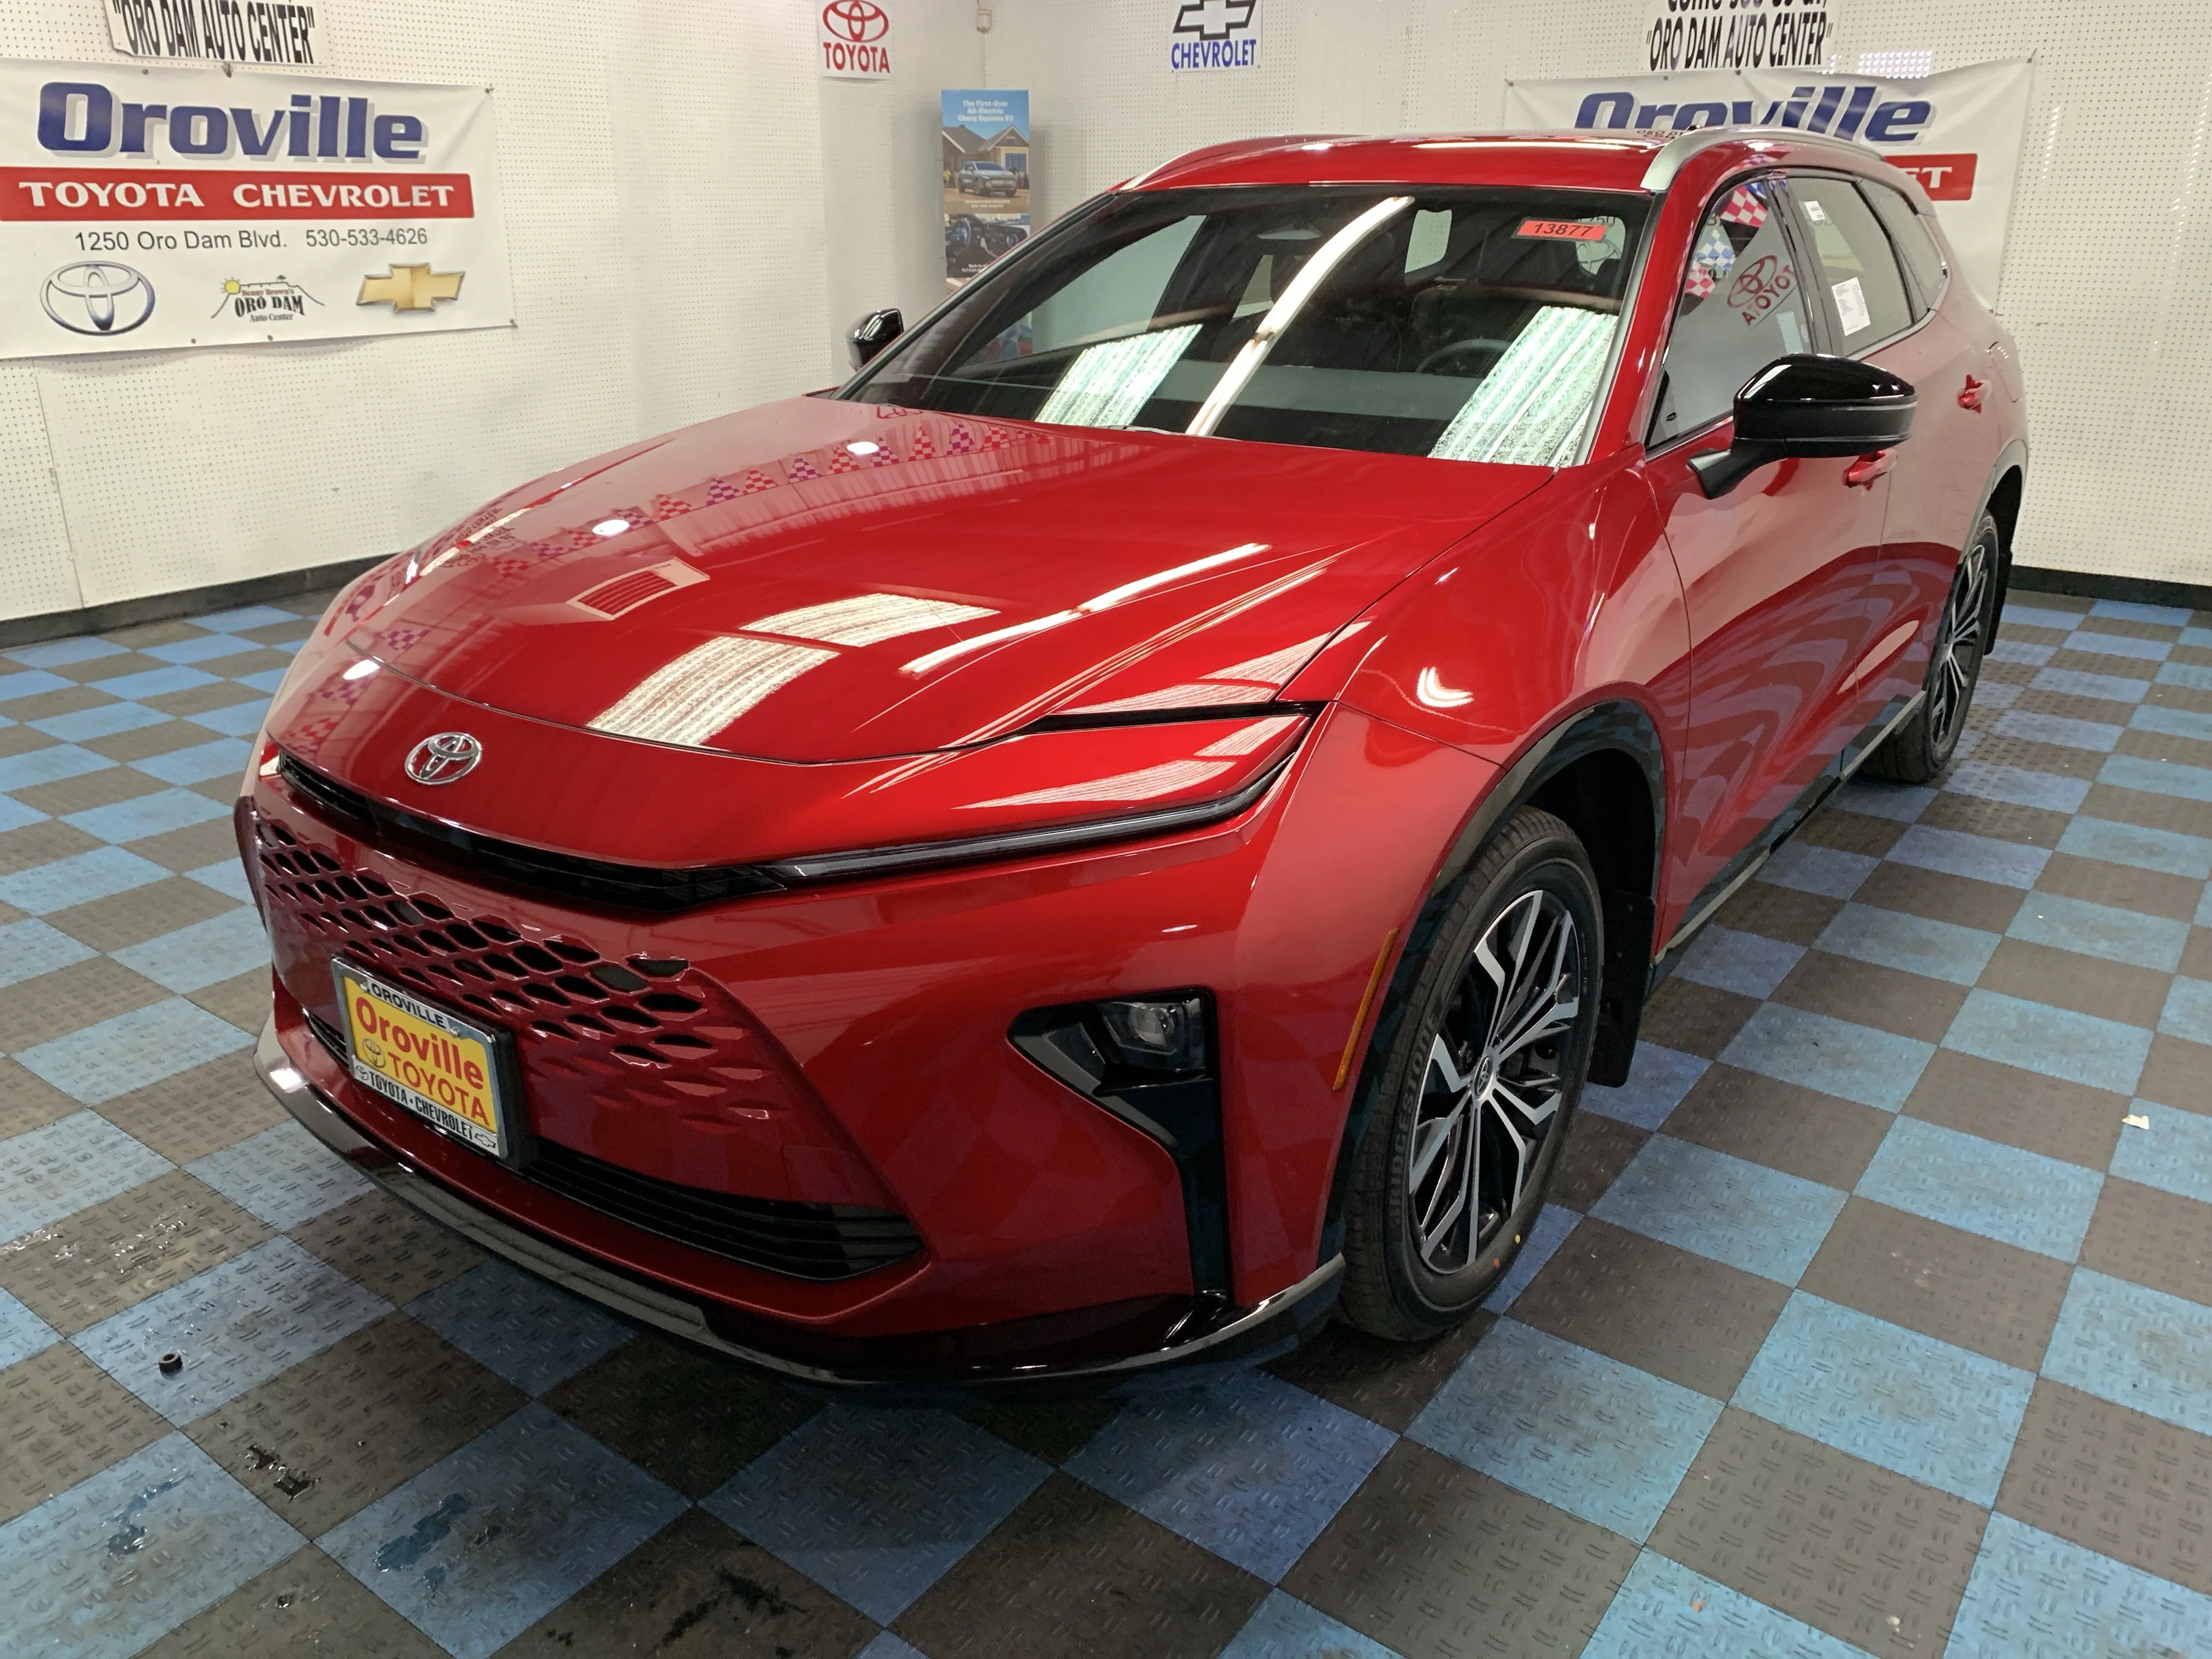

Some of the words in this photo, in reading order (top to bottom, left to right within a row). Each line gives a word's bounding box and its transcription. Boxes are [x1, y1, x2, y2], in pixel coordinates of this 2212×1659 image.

[113, 0, 161, 55] "ORO
[160, 0, 201, 58] DAM
[201, 0, 246, 61] AUTO
[246, 1, 316, 64] CENTER"
[1171, 38, 1256, 69] CHEVROLET
[1646, 16, 1684, 71] "ORO
[1684, 15, 1723, 69] DAM
[1723, 12, 1767, 69] AUTO
[1769, 11, 1834, 67] CENTER"
[823, 41, 890, 73] TOYOTA
[37, 82, 422, 159] Oroville
[1573, 85, 1932, 143] Oroville
[19, 182, 205, 207] TOYOTA
[233, 183, 454, 207] CHEVROLET
[75, 231, 129, 251] 1250
[137, 231, 177, 250] Oro
[184, 230, 232, 249] Dam
[238, 229, 287, 248] Blvd.
[306, 228, 428, 247] 530-533-4626
[1534, 223, 1594, 236] 13877
[234, 296, 267, 318] ORO
[271, 295, 305, 316] DAM
[250, 314, 268, 323] Auto
[269, 313, 294, 321] Center
[370, 983, 447, 1030] OROVILLE
[356, 996, 484, 1090] Oroville
[369, 1071, 409, 1107] TOYOTA
[414, 1096, 473, 1140] CHEVROLET
[387, 1051, 490, 1126] TOYOTA
